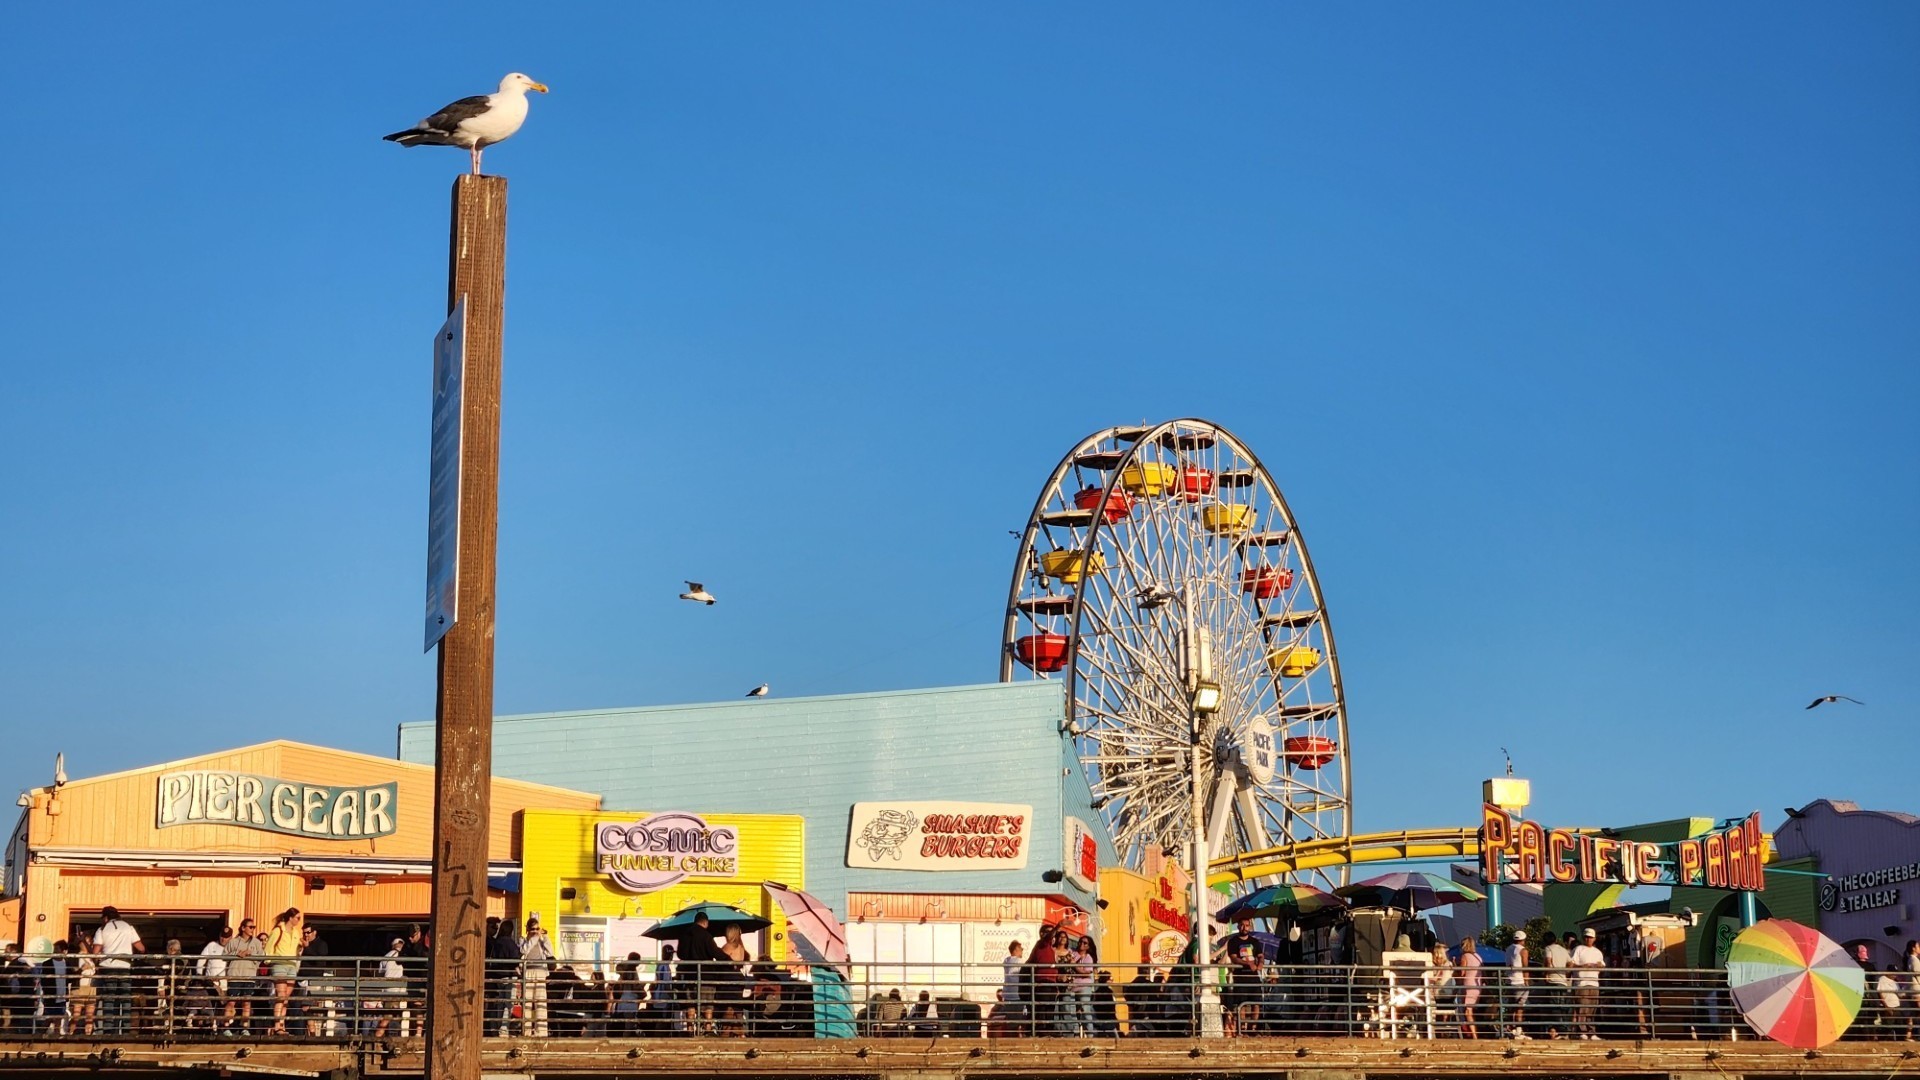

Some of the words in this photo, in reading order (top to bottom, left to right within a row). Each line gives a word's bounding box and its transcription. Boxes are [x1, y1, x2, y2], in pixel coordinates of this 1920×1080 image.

[1256, 750, 1269, 768] PARK
[161, 773, 266, 825] PIER
[271, 783, 394, 836] GEAR
[921, 814, 1024, 835] SMASHIE'S
[920, 835, 1022, 858] BURGERS
[1482, 801, 1660, 884] PACIFIC
[1678, 809, 1765, 892] PARK
[600, 853, 680, 872] FUNNEL
[681, 855, 735, 873] CAKE
[1160, 876, 1172, 901] The
